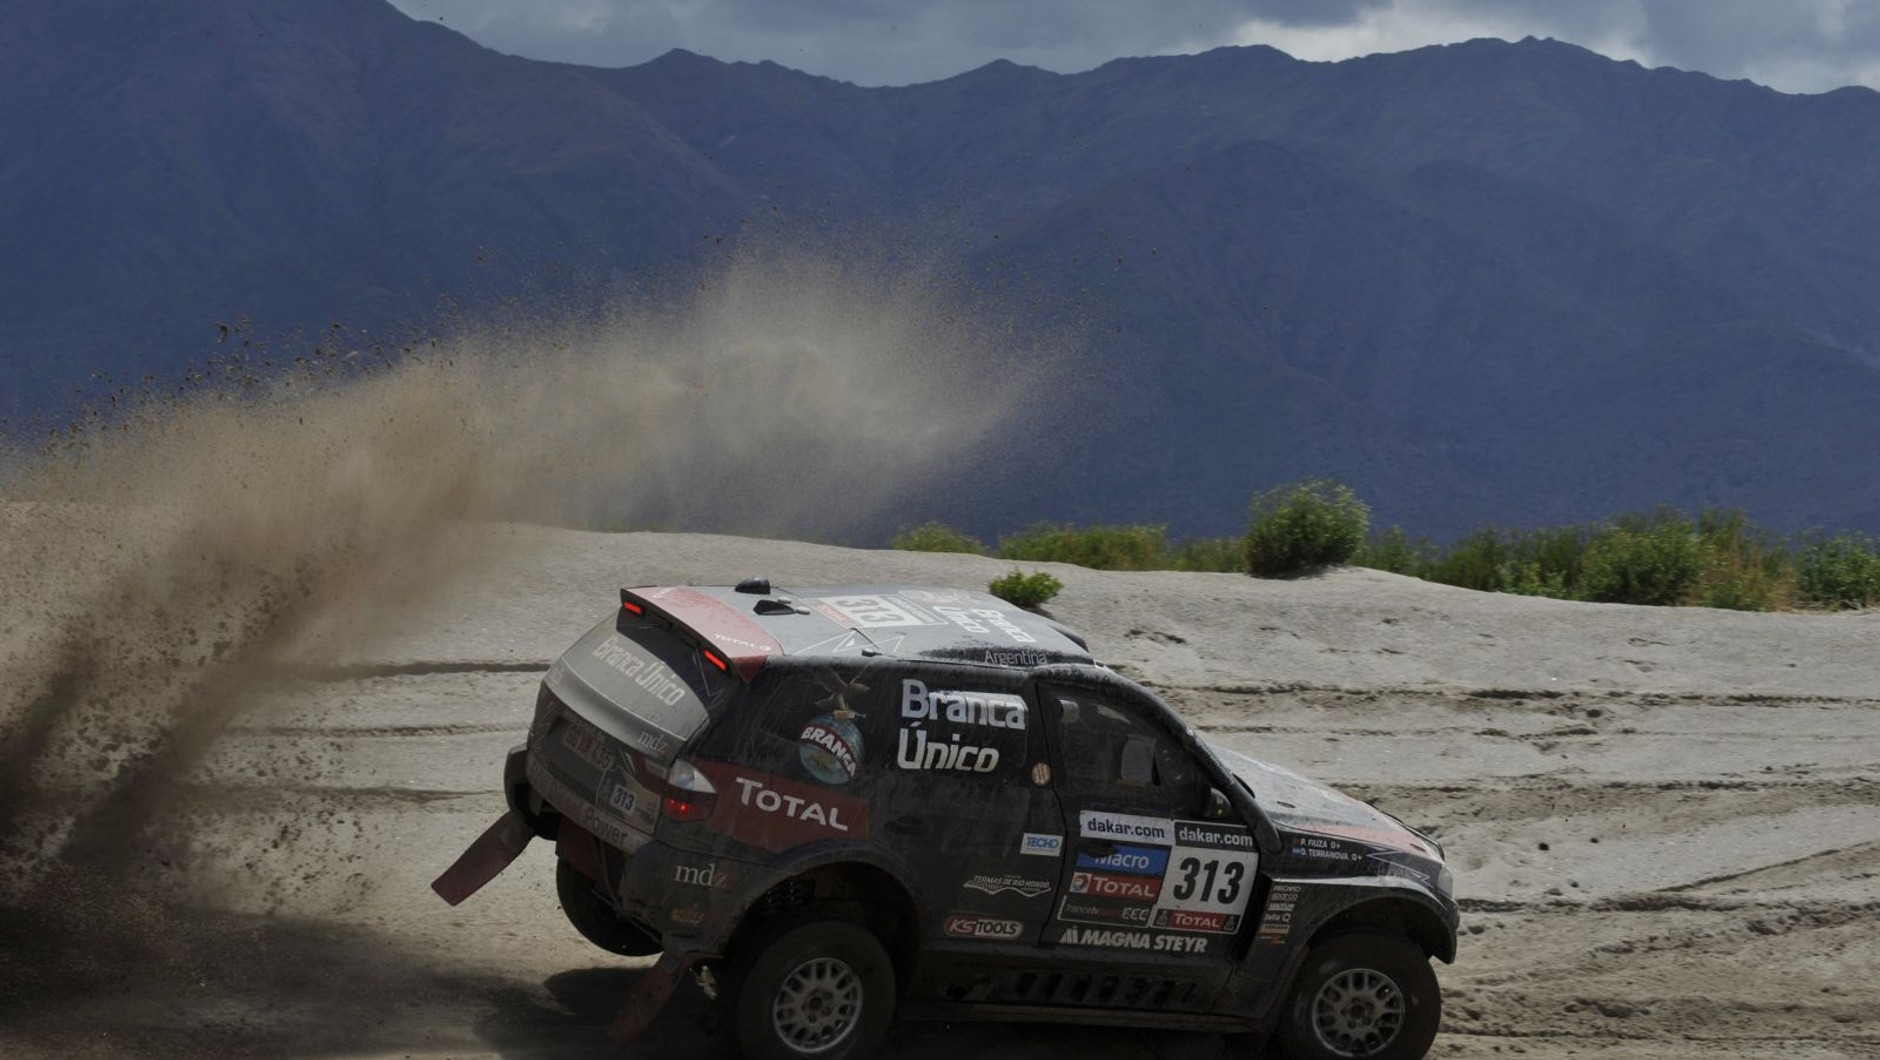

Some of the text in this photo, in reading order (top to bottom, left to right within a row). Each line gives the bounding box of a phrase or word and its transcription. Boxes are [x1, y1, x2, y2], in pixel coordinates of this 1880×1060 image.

[592, 635, 645, 677] Branca
[983, 651, 1046, 667] Argentina
[901, 678, 1026, 730] Branca
[638, 731, 669, 751] mdz
[801, 726, 857, 778] BRANCA
[897, 721, 1000, 774] Único
[613, 788, 635, 811] 313
[736, 776, 849, 832] TOTAL
[586, 806, 629, 845] Power
[1088, 818, 1165, 838] dakar.com
[1179, 826, 1253, 847] dakar.com
[1026, 837, 1059, 849] TECHO
[1308, 839, 1328, 849] FIUZA
[1308, 849, 1349, 861] TERRANOVA
[674, 863, 728, 889] mdz
[1092, 876, 1156, 898] TOTAL
[1173, 857, 1245, 905] 313
[950, 919, 1017, 935] KS TOOLS
[1174, 913, 1221, 928] TOTAL
[1080, 930, 1209, 953] MAGNA STEYR
